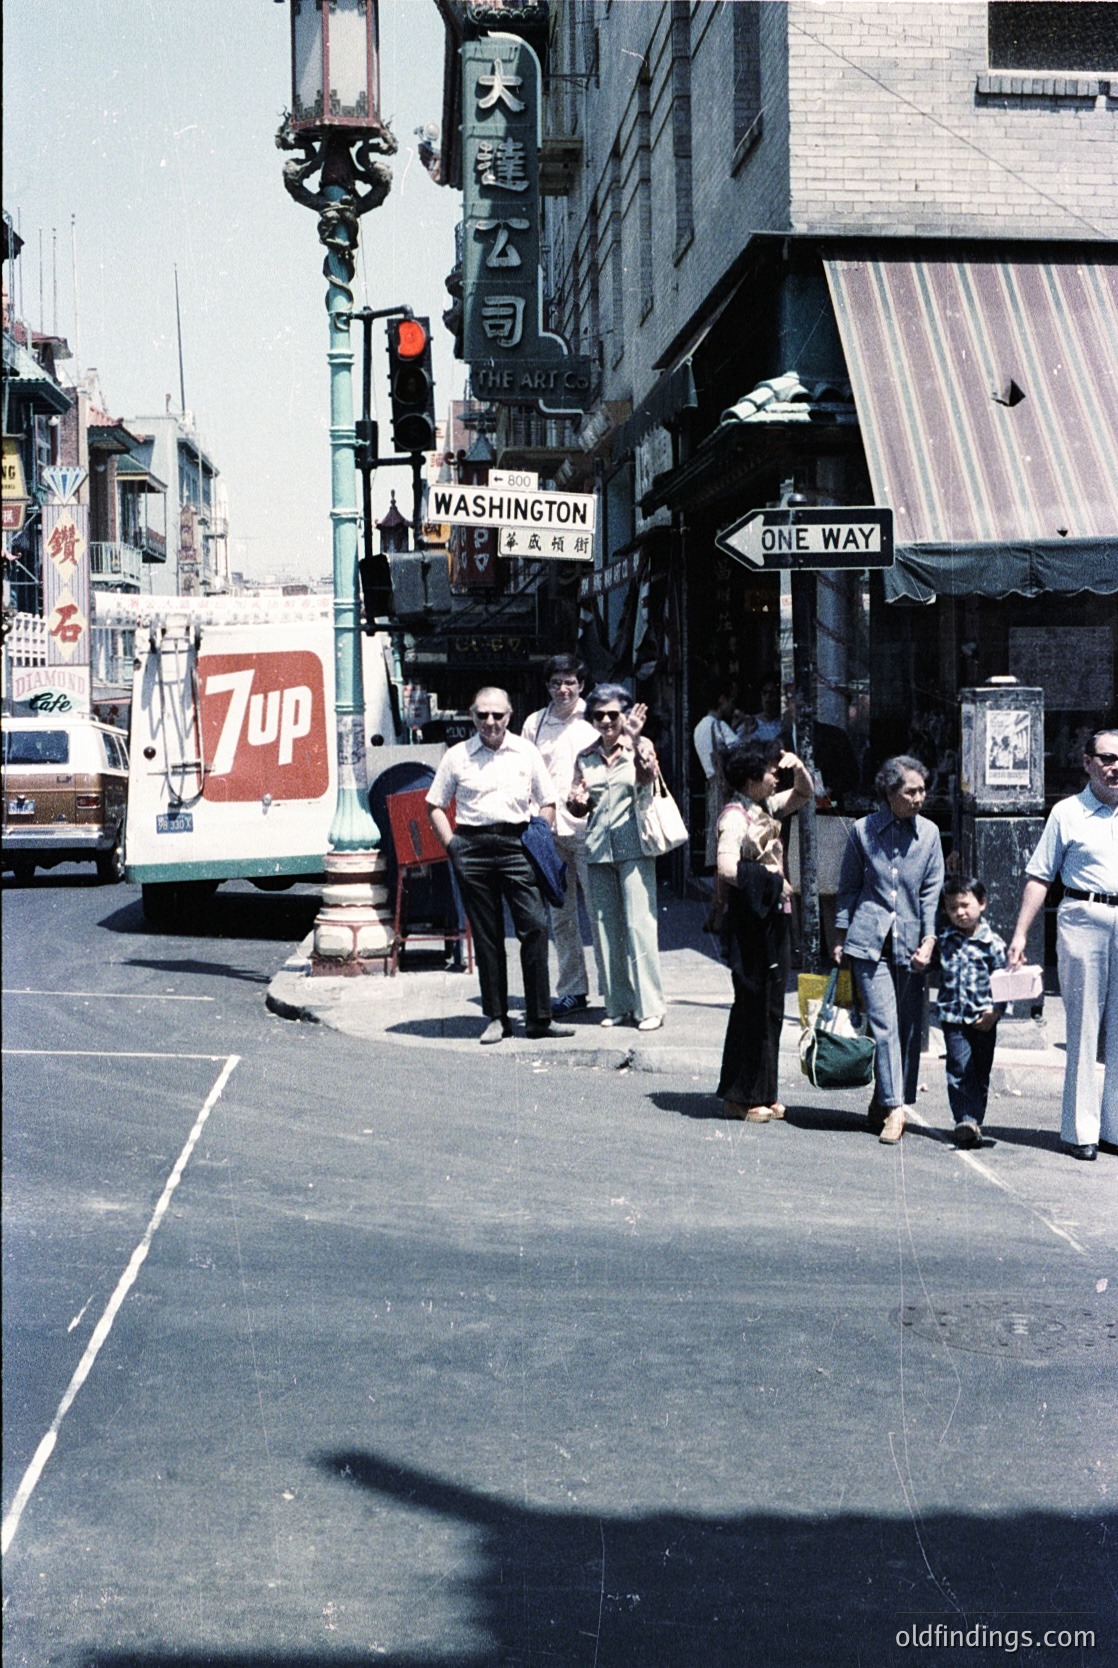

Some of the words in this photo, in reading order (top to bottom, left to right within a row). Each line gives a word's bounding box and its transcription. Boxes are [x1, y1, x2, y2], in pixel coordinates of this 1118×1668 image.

[477, 370, 513, 388] THE
[521, 370, 558, 389] ART
[507, 474, 531, 488] 800
[434, 492, 588, 524] WASHINGTON
[761, 527, 810, 551] ONE
[822, 526, 876, 551] WAY
[14, 668, 86, 699] DIAMOND
[28, 692, 72, 713] Cafe
